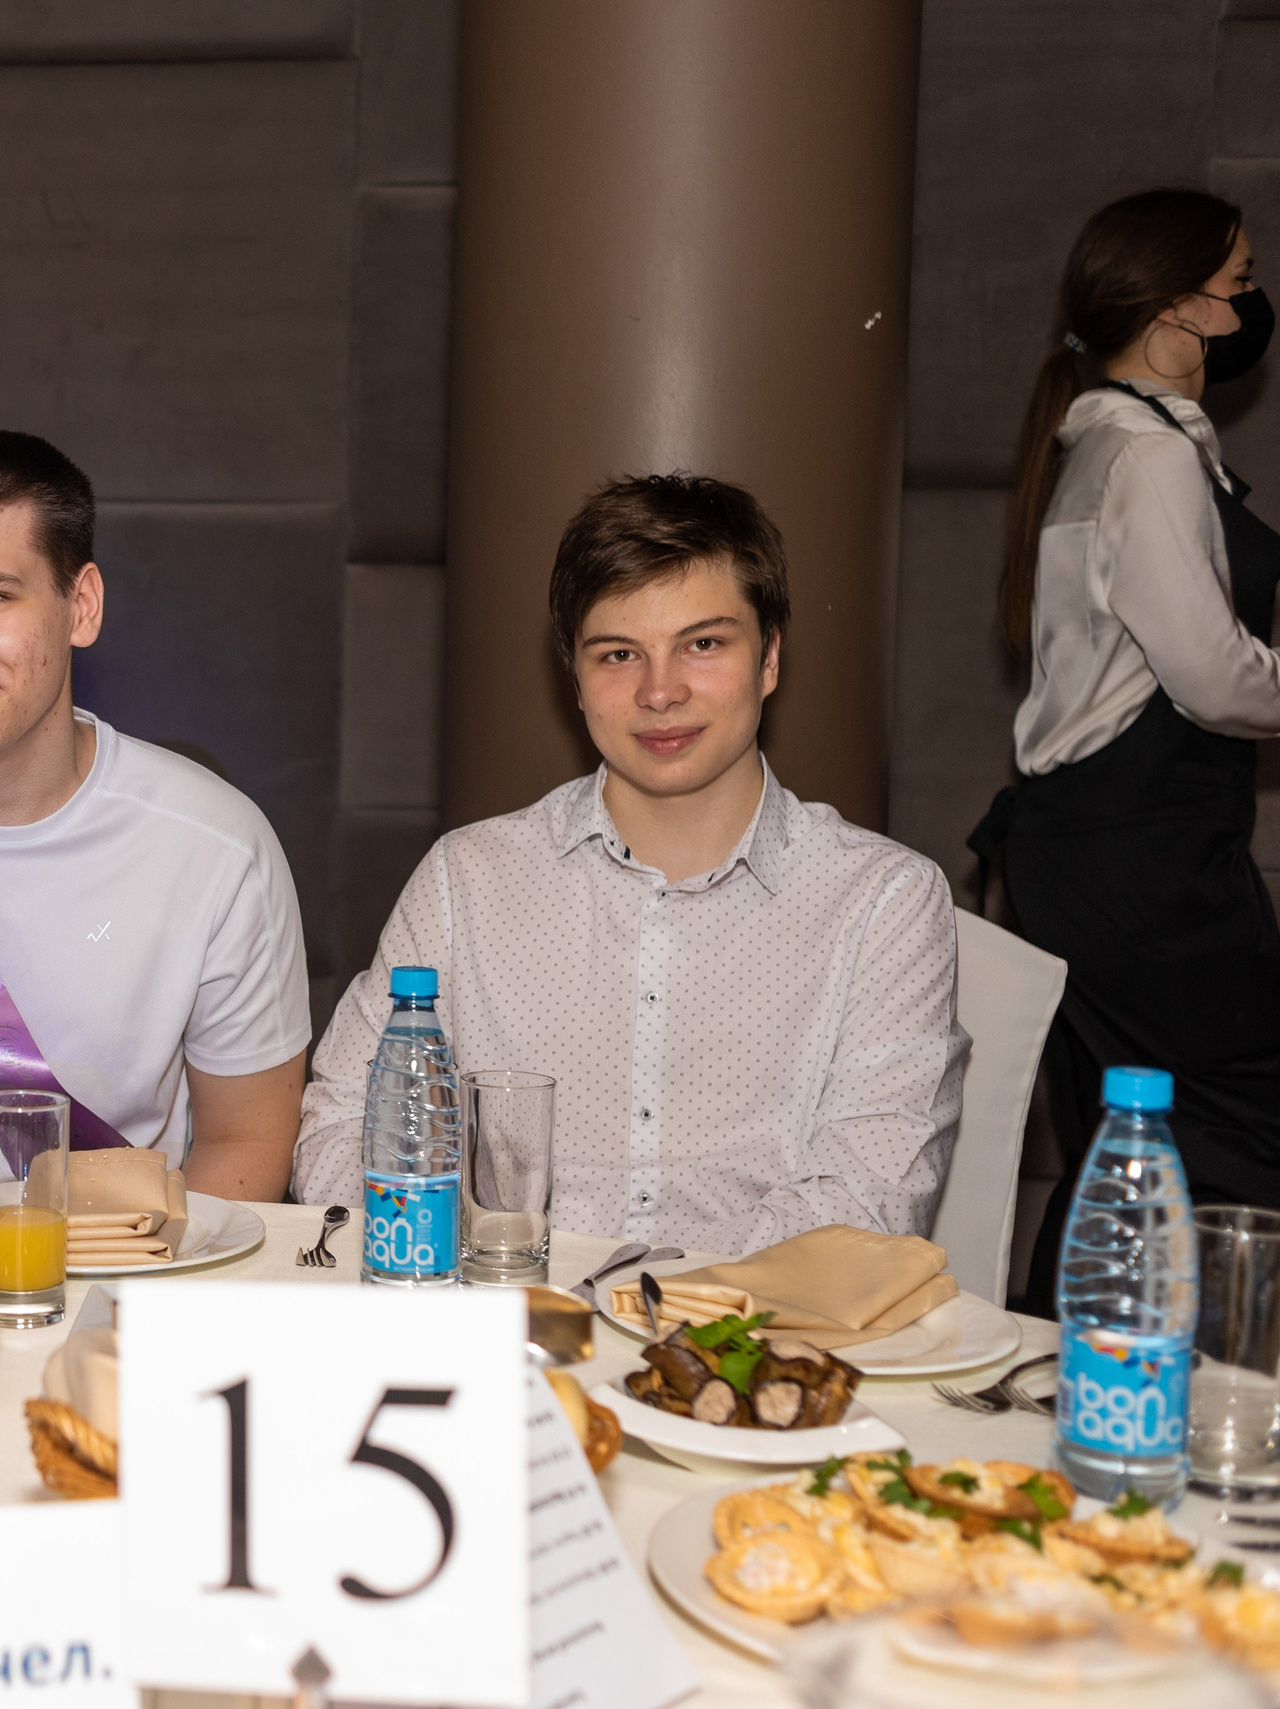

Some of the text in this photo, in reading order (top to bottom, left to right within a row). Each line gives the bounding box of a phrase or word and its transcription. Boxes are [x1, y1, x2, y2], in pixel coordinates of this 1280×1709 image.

[364, 1234, 435, 1268] aqua
[1076, 1371, 1166, 1417] bon
[1077, 1410, 1183, 1452] aqua
[194, 1373, 456, 1605] 15
